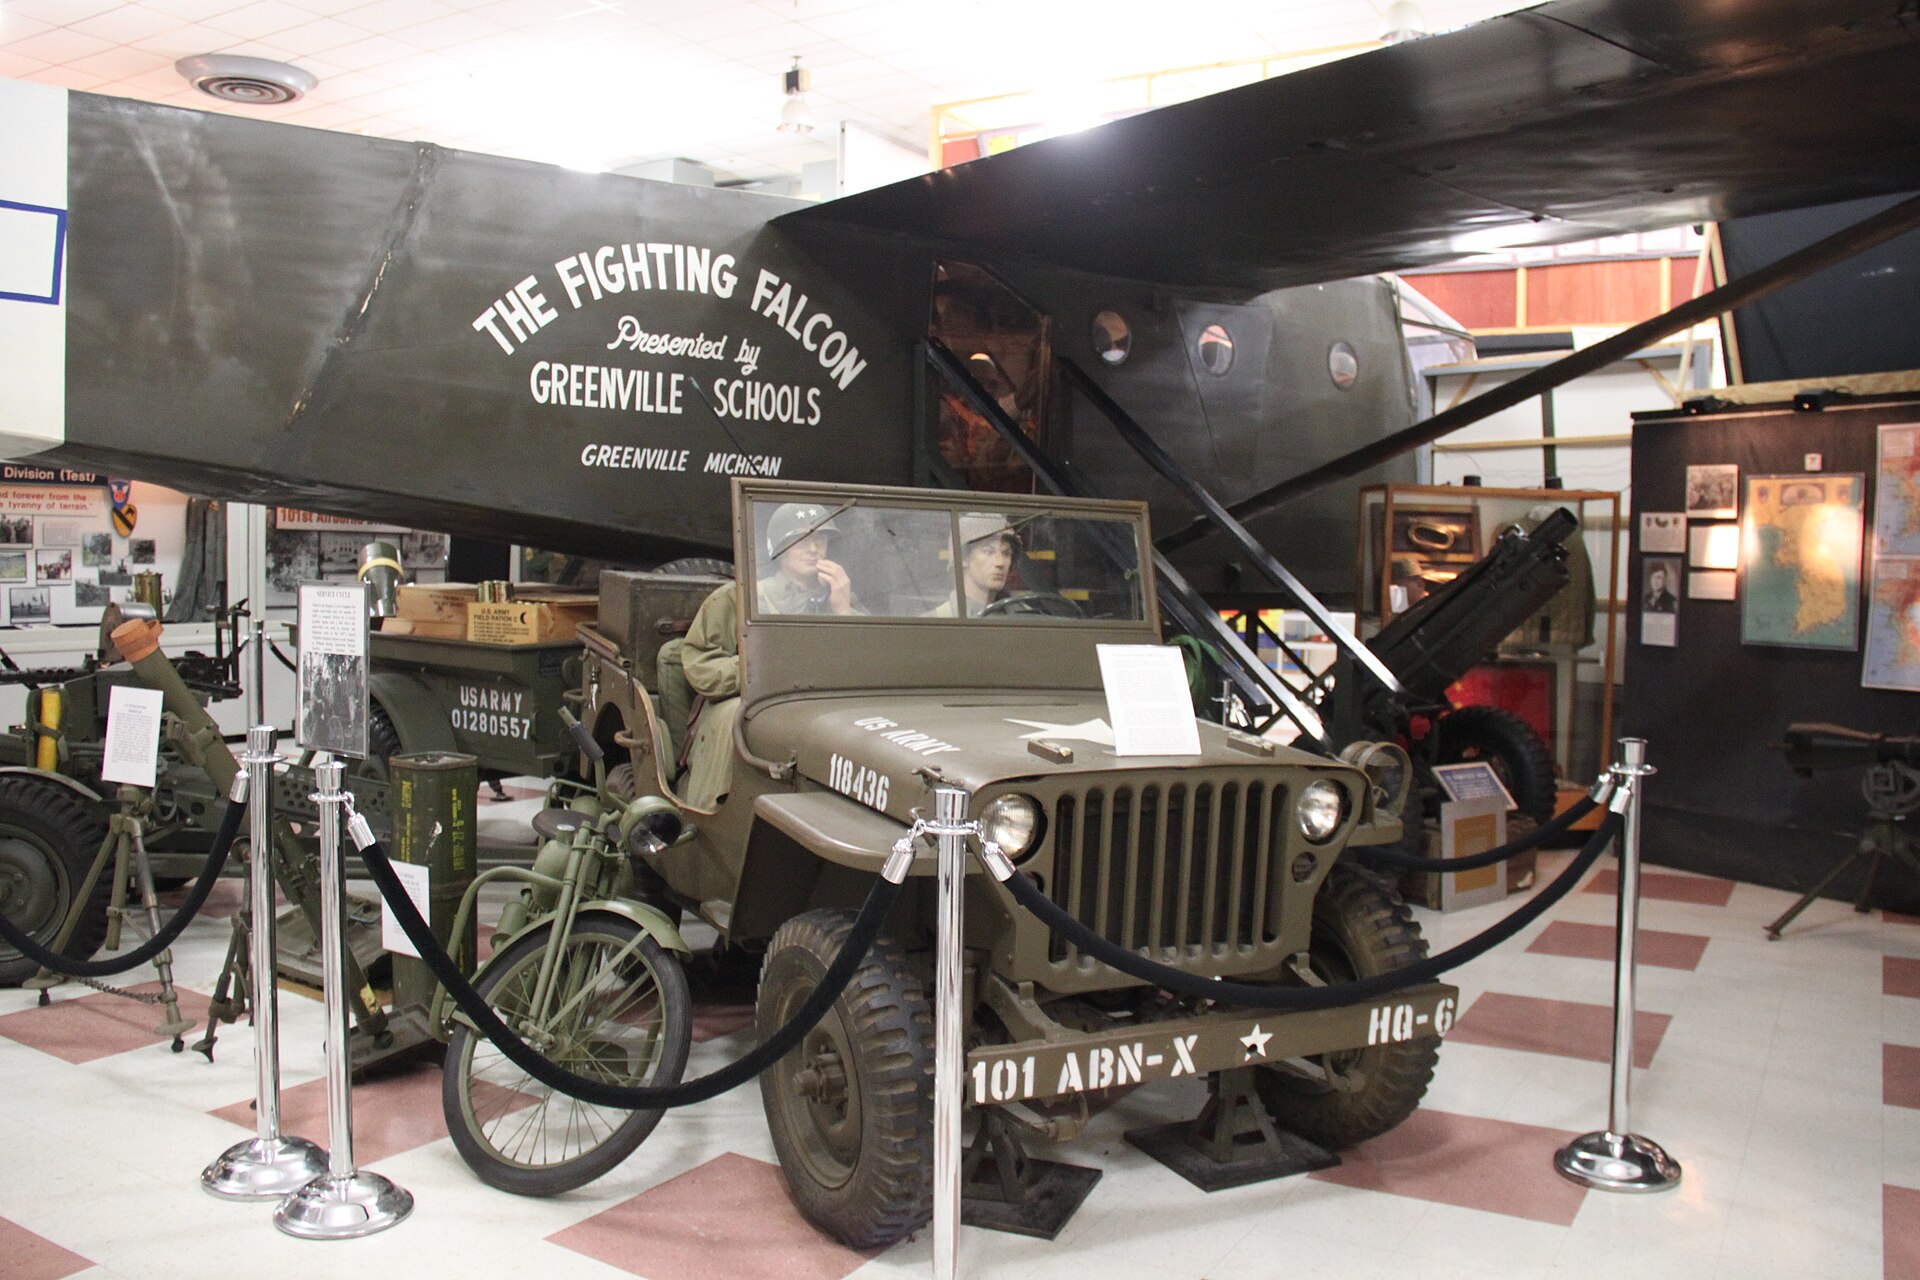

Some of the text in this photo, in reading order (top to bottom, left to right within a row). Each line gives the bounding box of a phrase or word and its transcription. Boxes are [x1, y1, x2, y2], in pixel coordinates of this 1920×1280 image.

[472, 242, 867, 391] THE FIGHTING FALCON
[606, 314, 761, 376] Presented by
[530, 360, 822, 426] GREENVILLE SCHOOLS
[3, 466, 96, 483] Division (Test)
[580, 443, 782, 477] GREENVILLE MICHIGAN
[8, 501, 42, 511] tyranny
[46, 502, 55, 510] of
[13, 491, 44, 500] forever
[49, 493, 69, 501] from
[73, 494, 87, 502] the
[451, 708, 531, 740] 01280557
[854, 716, 961, 756] US ARMY
[829, 752, 890, 812] 118436
[1367, 998, 1455, 1046] HQ-6
[972, 1034, 1198, 1104] 101 ABN-X
